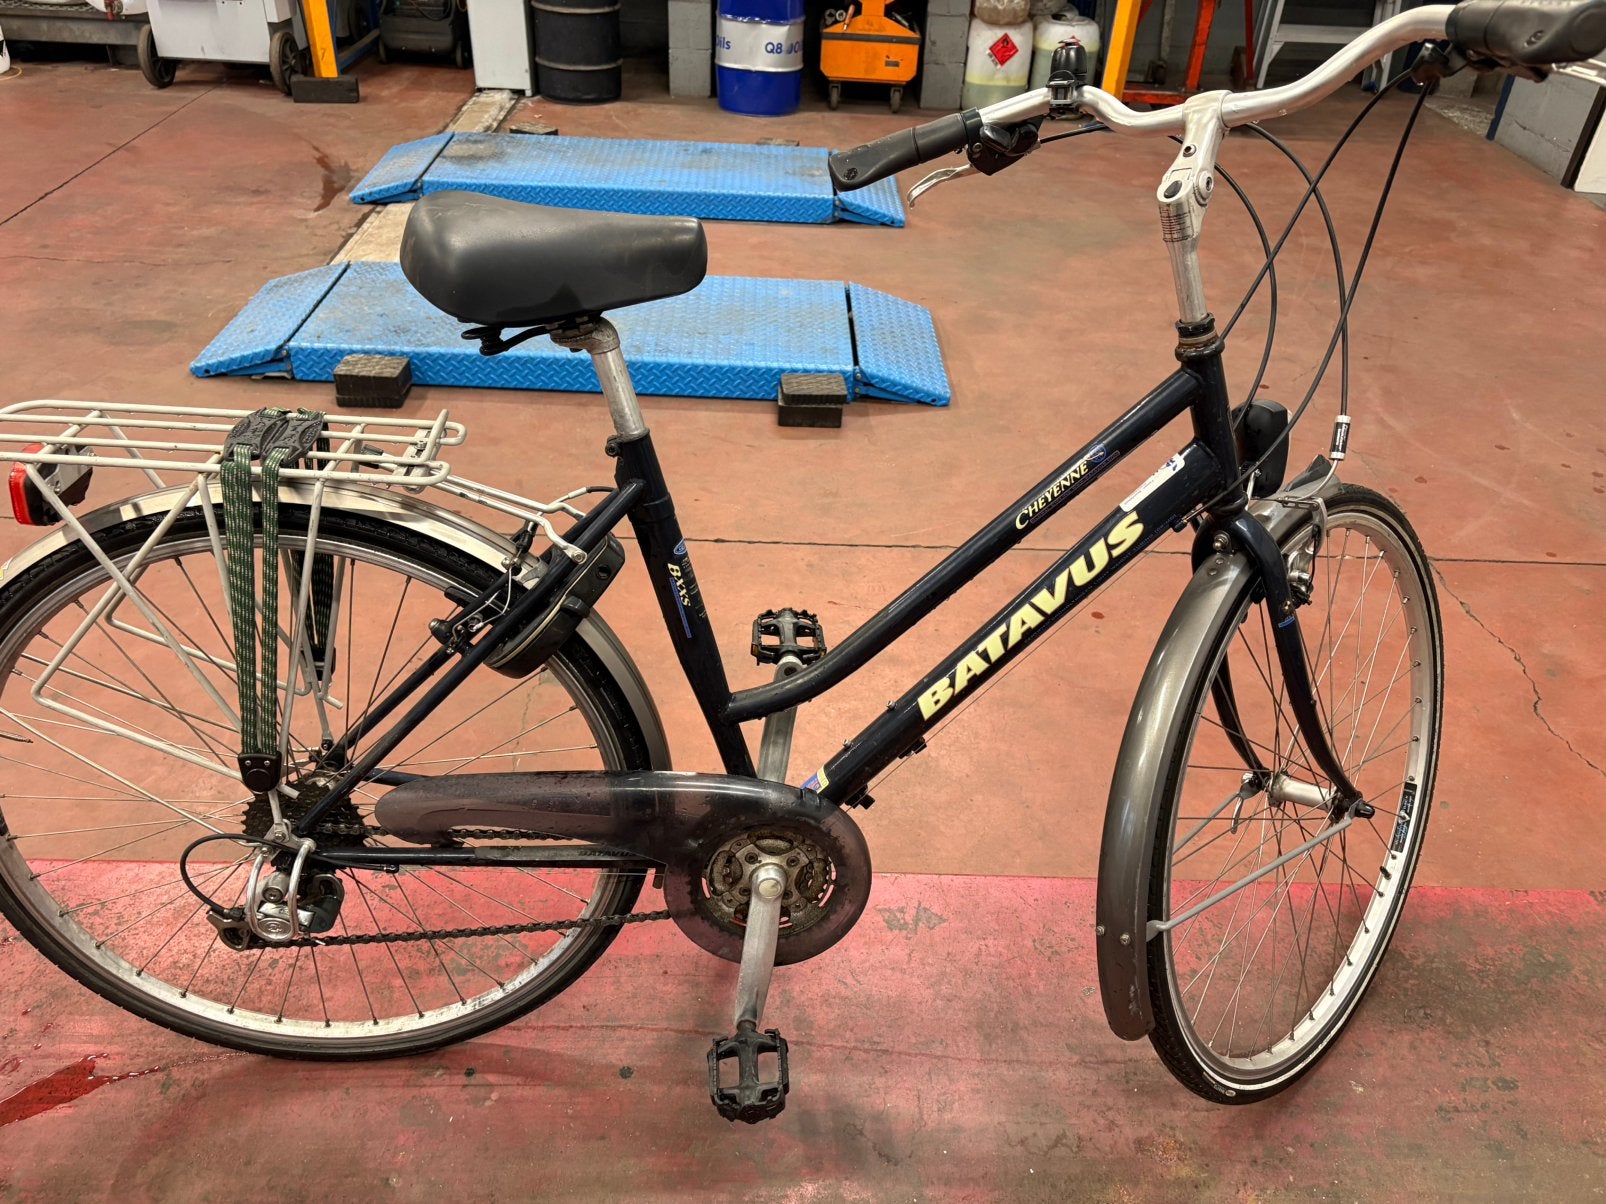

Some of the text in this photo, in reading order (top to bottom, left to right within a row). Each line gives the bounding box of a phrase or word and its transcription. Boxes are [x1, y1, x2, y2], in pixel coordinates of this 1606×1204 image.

[765, 42, 783, 54] Q8
[1015, 460, 1089, 530] CHEYENNE
[917, 511, 1144, 721] BATAVUS
